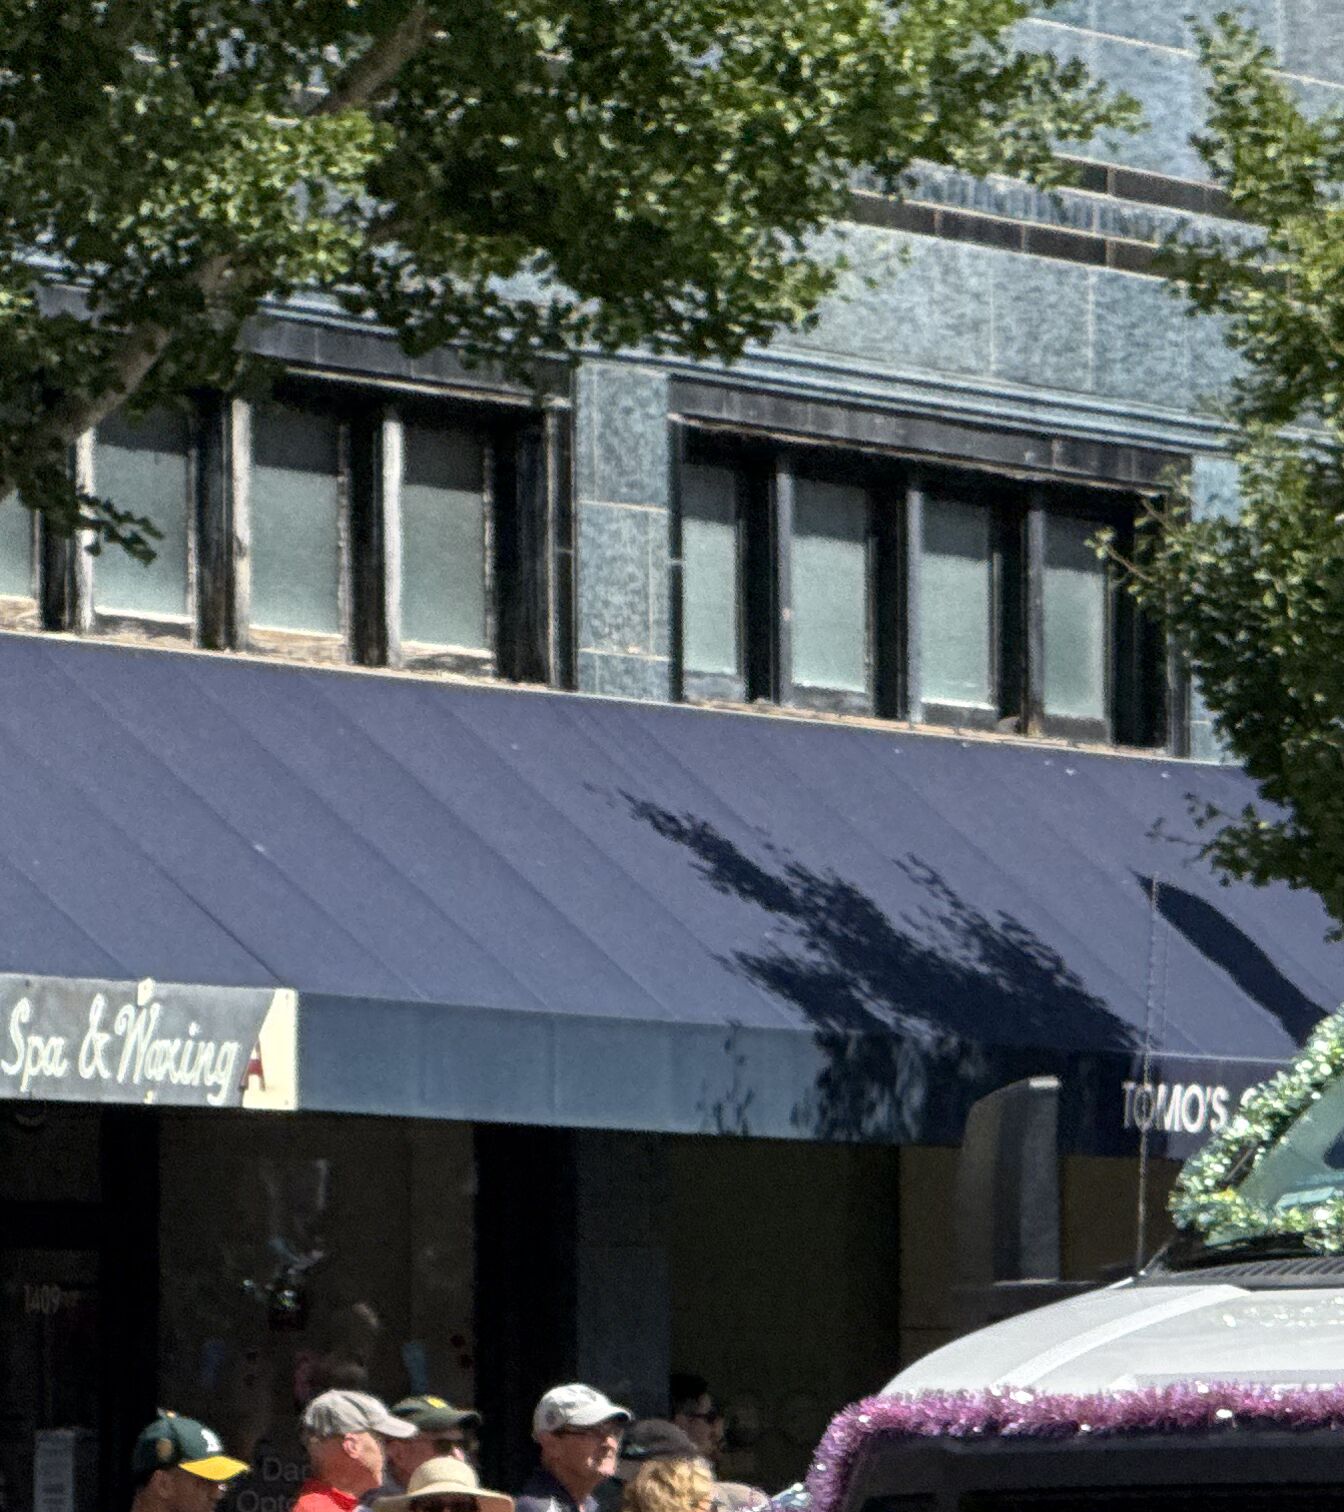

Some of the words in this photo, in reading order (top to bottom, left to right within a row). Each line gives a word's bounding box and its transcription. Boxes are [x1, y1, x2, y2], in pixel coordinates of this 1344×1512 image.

[1, 997, 68, 1093] Spa
[78, 992, 113, 1080] &
[114, 1002, 241, 1106] Waxing
[1122, 1081, 1230, 1134] TOMO'S
